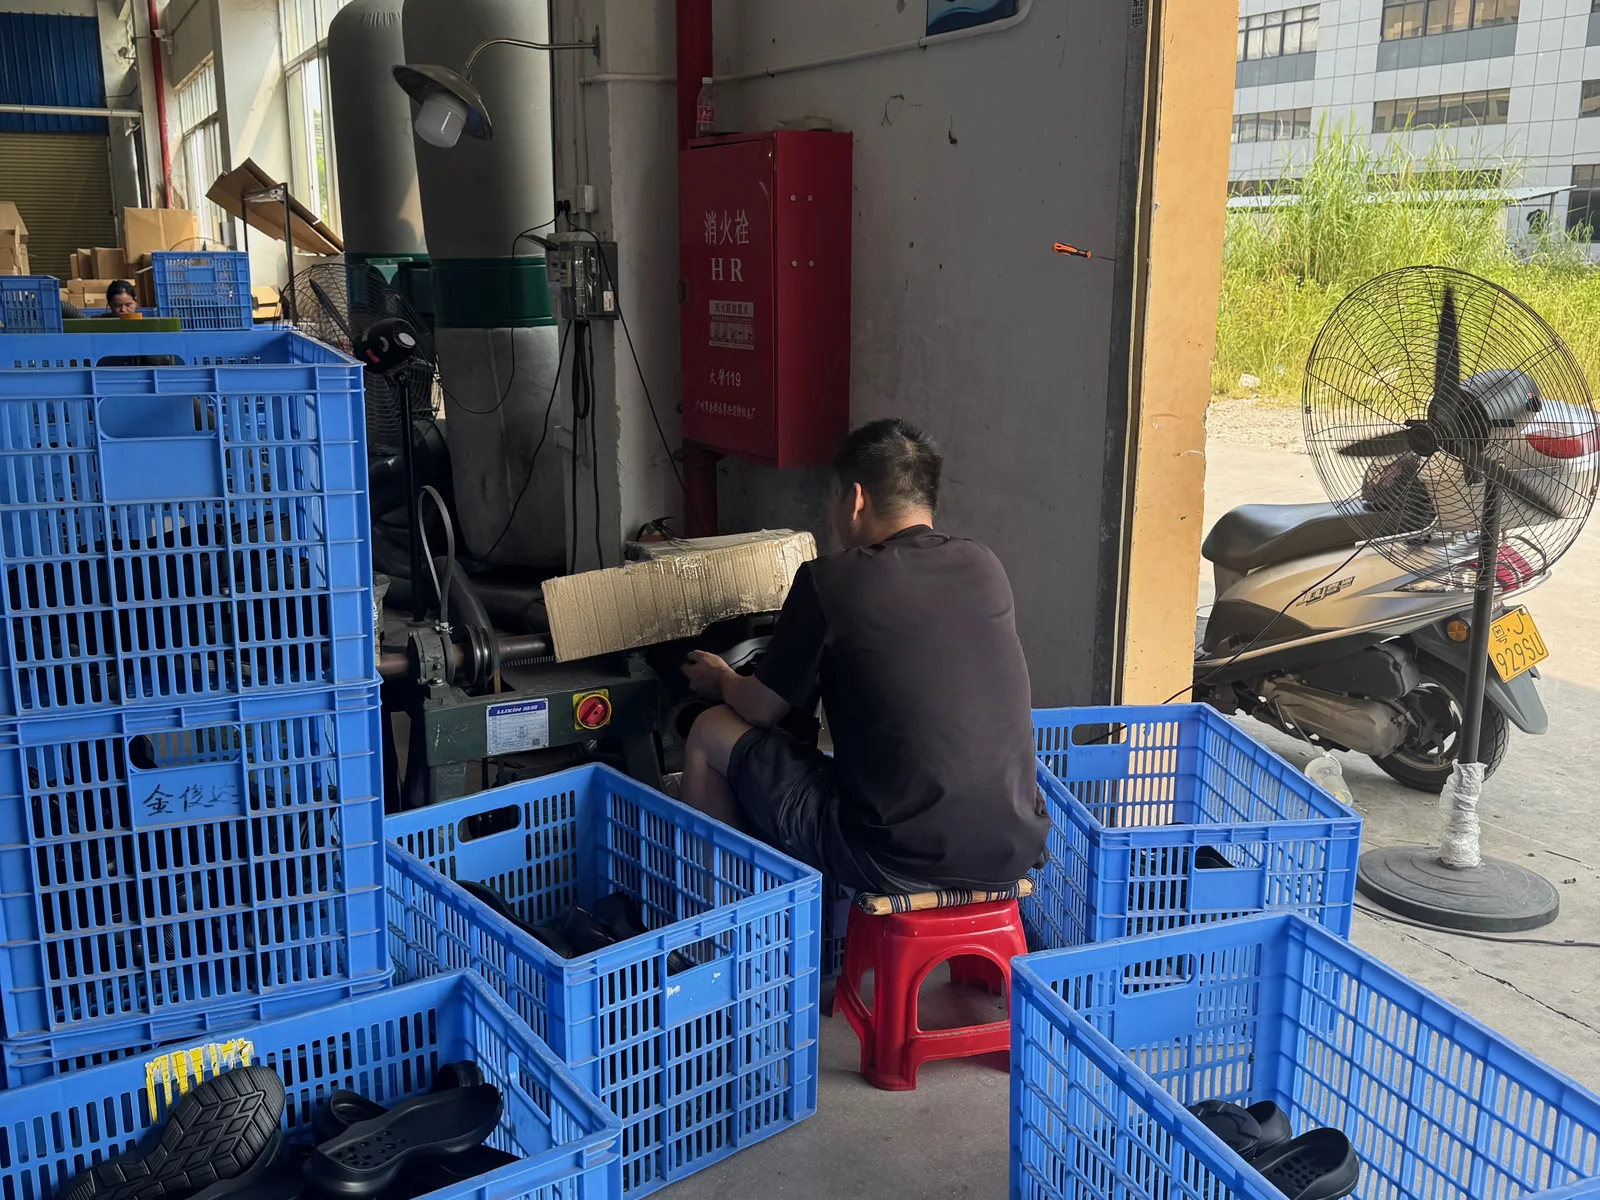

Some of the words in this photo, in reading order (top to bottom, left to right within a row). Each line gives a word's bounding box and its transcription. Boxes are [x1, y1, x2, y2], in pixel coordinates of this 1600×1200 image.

[704, 209, 749, 246] 消火栓
[1496, 632, 1545, 677] 929SU
